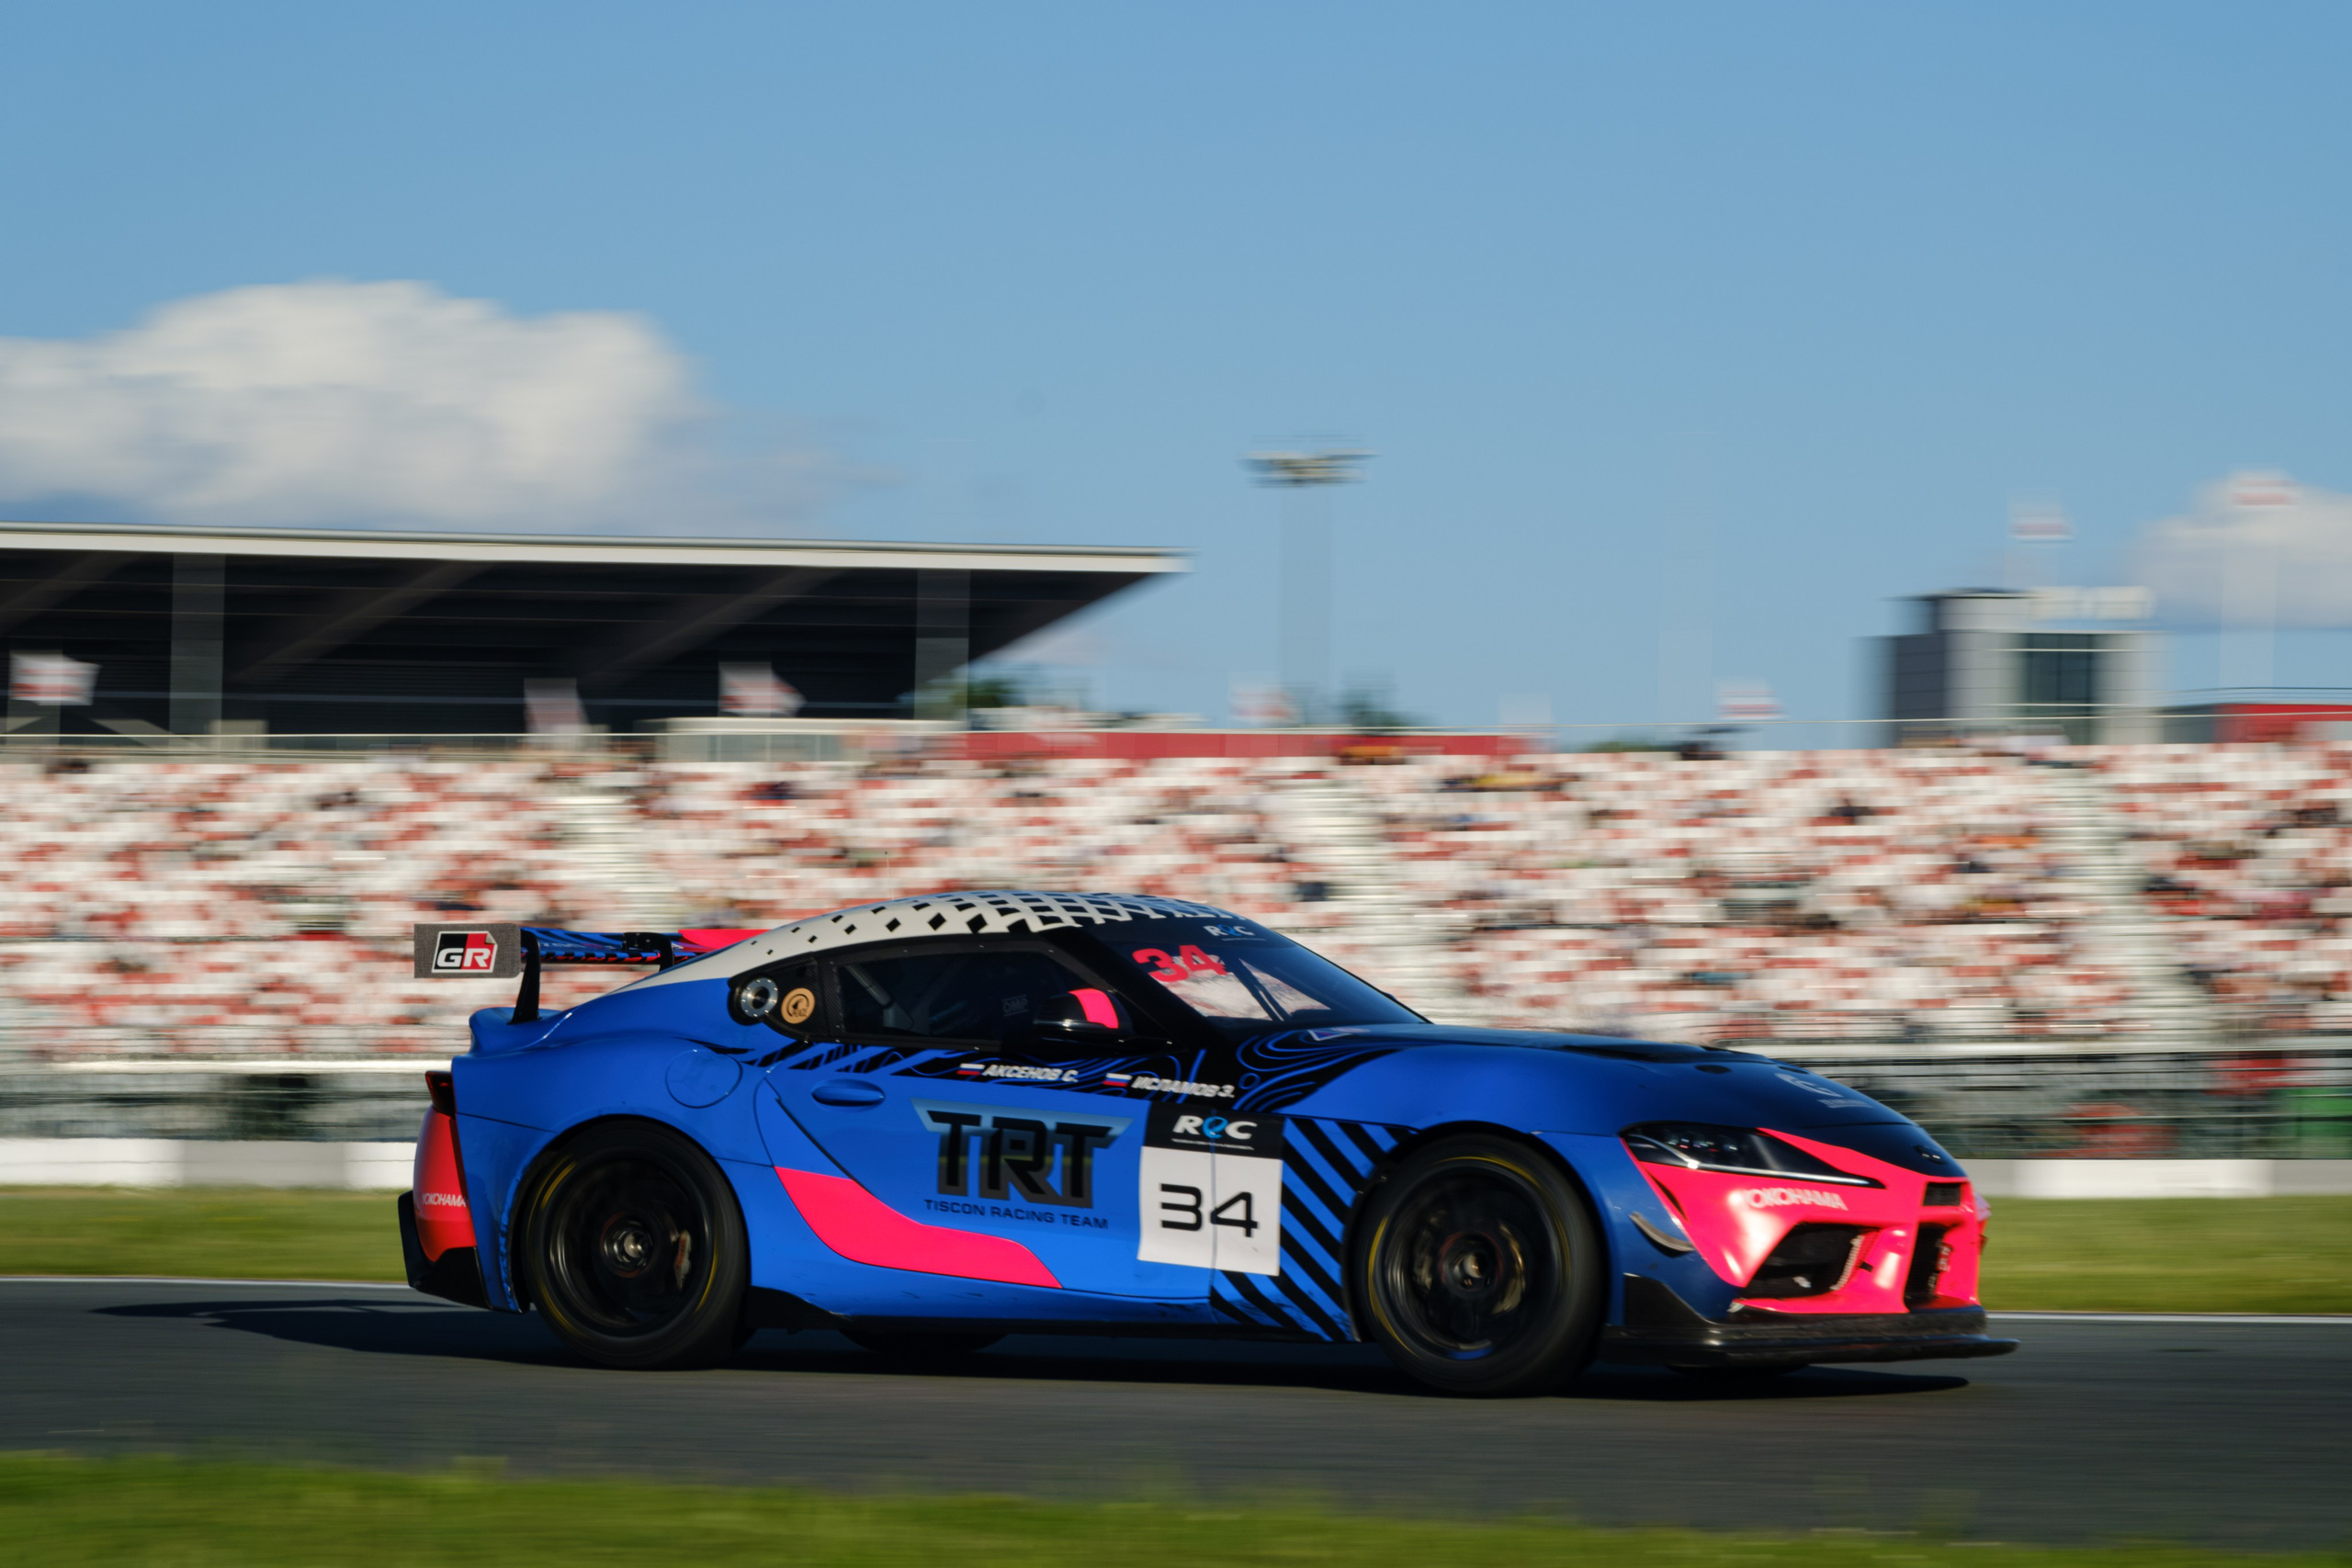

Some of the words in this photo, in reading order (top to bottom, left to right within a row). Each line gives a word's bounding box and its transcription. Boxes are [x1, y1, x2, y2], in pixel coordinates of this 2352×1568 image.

[436, 947, 492, 967] GR
[1132, 944, 1228, 982] 34
[1002, 998, 1028, 1013] OMP
[919, 1104, 1125, 1204] TRT
[923, 1199, 986, 1216] TISCON
[989, 1206, 1056, 1224] RACING
[1059, 1213, 1110, 1229] TEAM
[1159, 1182, 1260, 1238] 34
